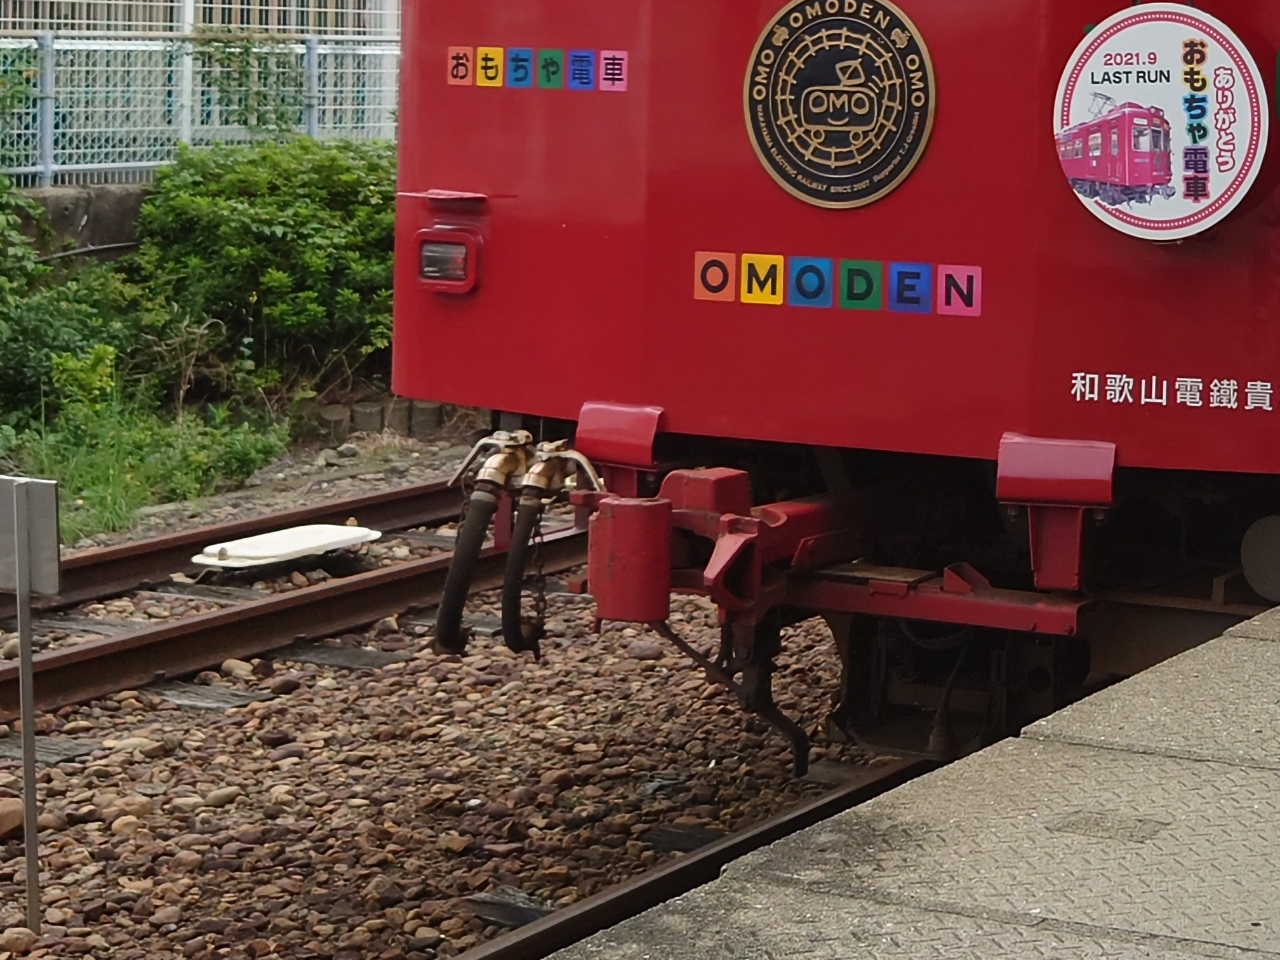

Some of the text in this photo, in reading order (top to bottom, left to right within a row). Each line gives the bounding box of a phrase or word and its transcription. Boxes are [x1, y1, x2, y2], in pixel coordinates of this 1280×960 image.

[753, 49, 774, 100] OMO
[906, 54, 925, 107] OMO
[1090, 70, 1171, 85] LAST RUN
[1103, 51, 1158, 66] 2021.9
[809, 91, 870, 115] OMO
[1182, 38, 1210, 203] おもちゃ電車
[1214, 66, 1236, 173] ありがとう
[700, 259, 974, 308] OMODEN
